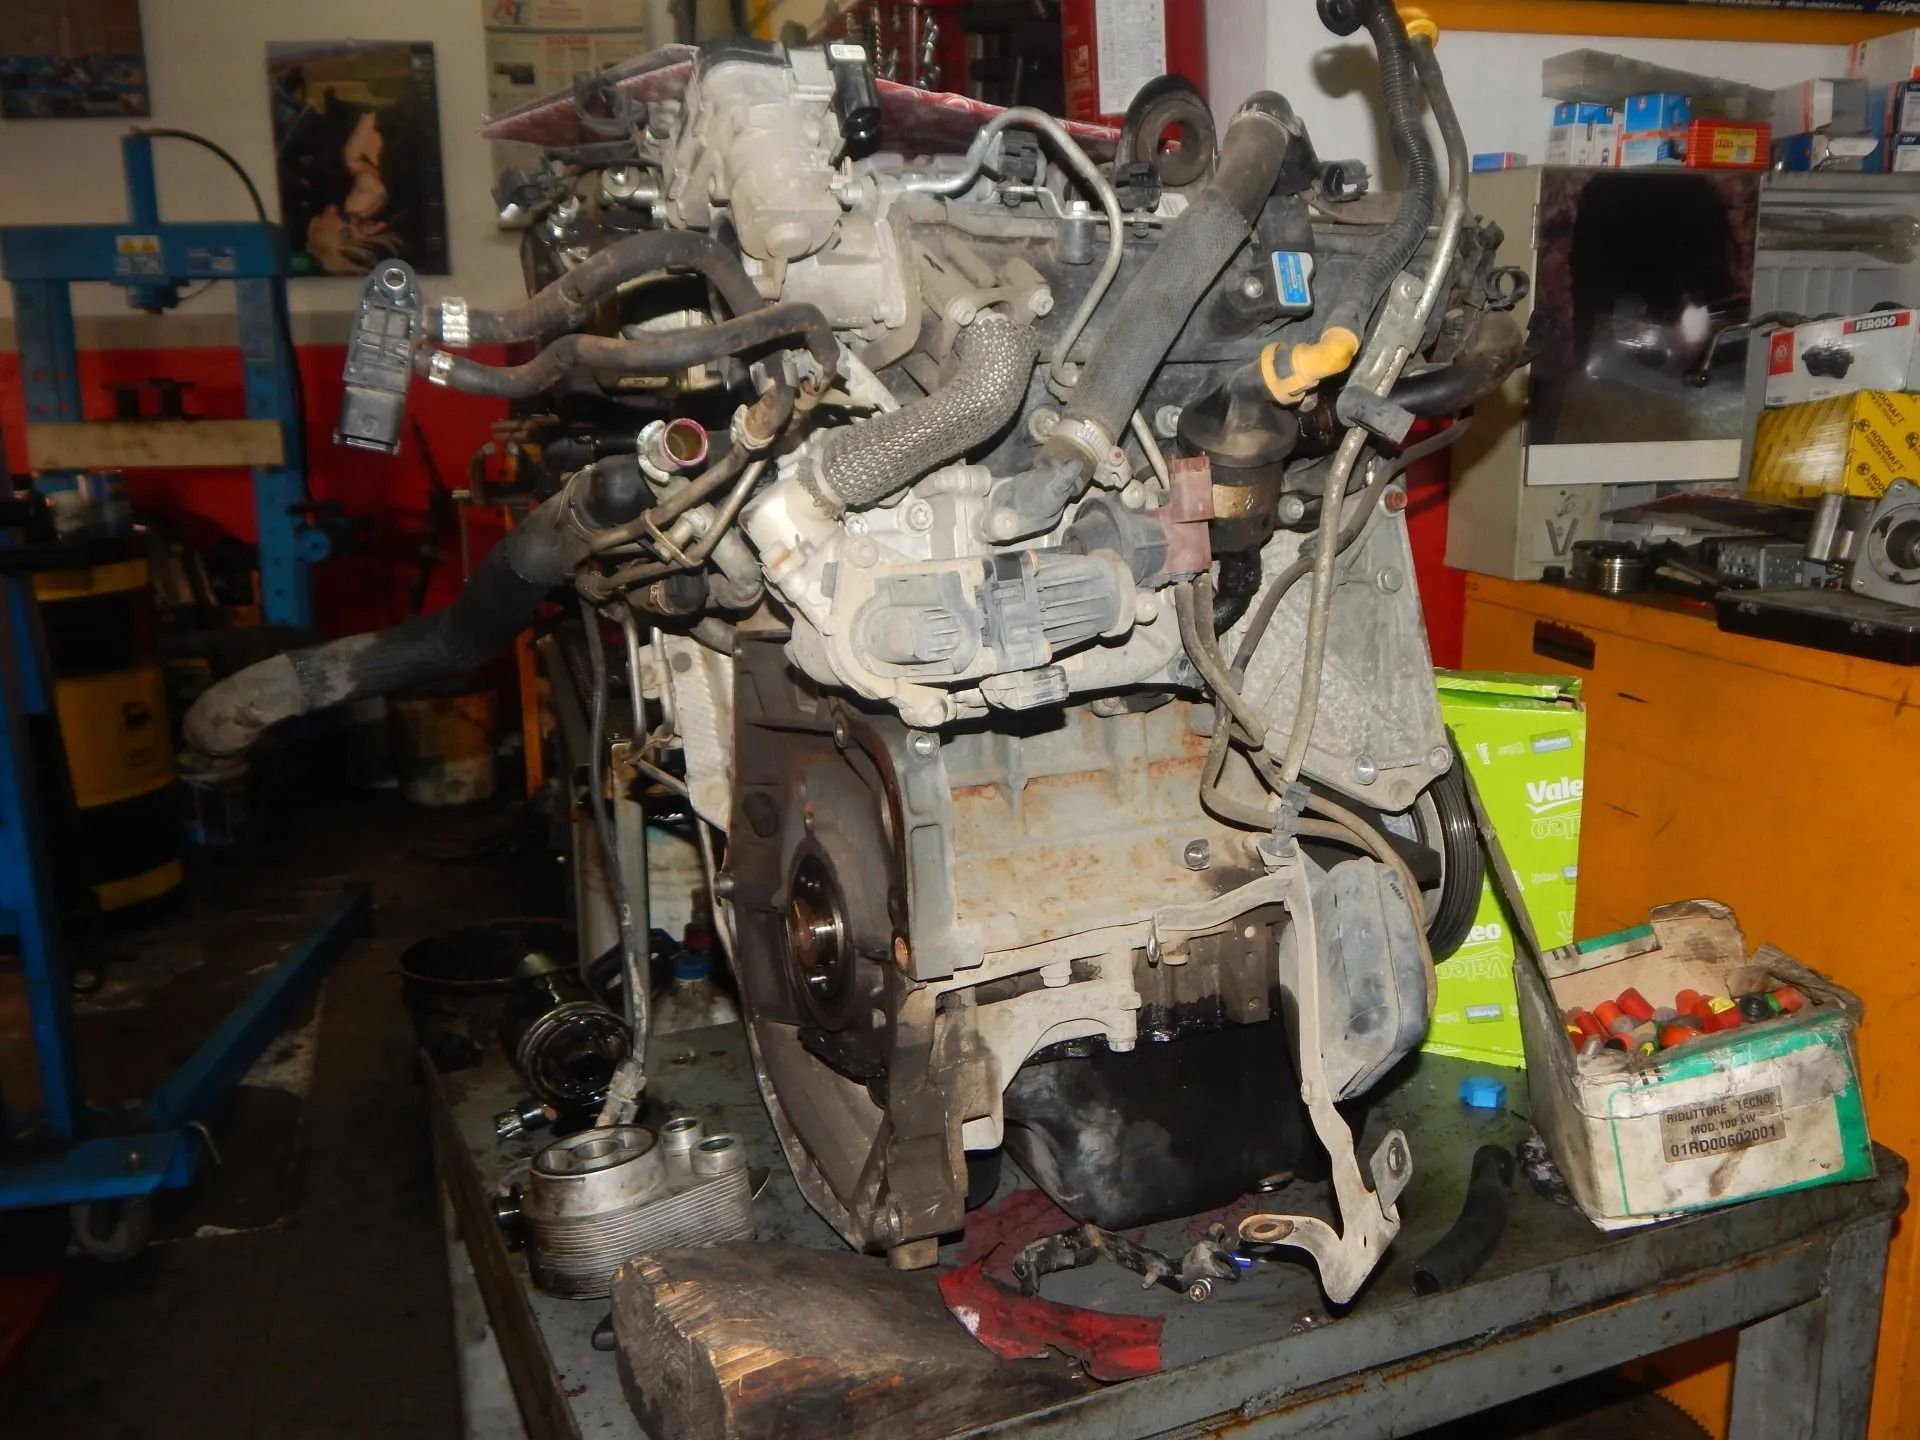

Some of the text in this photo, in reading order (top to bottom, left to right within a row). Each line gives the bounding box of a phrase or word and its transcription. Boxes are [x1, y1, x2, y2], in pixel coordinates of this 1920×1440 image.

[1856, 315, 1897, 331] FERODO
[1870, 430, 1904, 470] RODCRAFT
[1526, 776, 1583, 804] Vale
[1666, 1103, 1727, 1124] RIDUTTORE
[1740, 1113, 1757, 1125] kW
[1671, 1124, 1777, 1157] 01RD00602001
